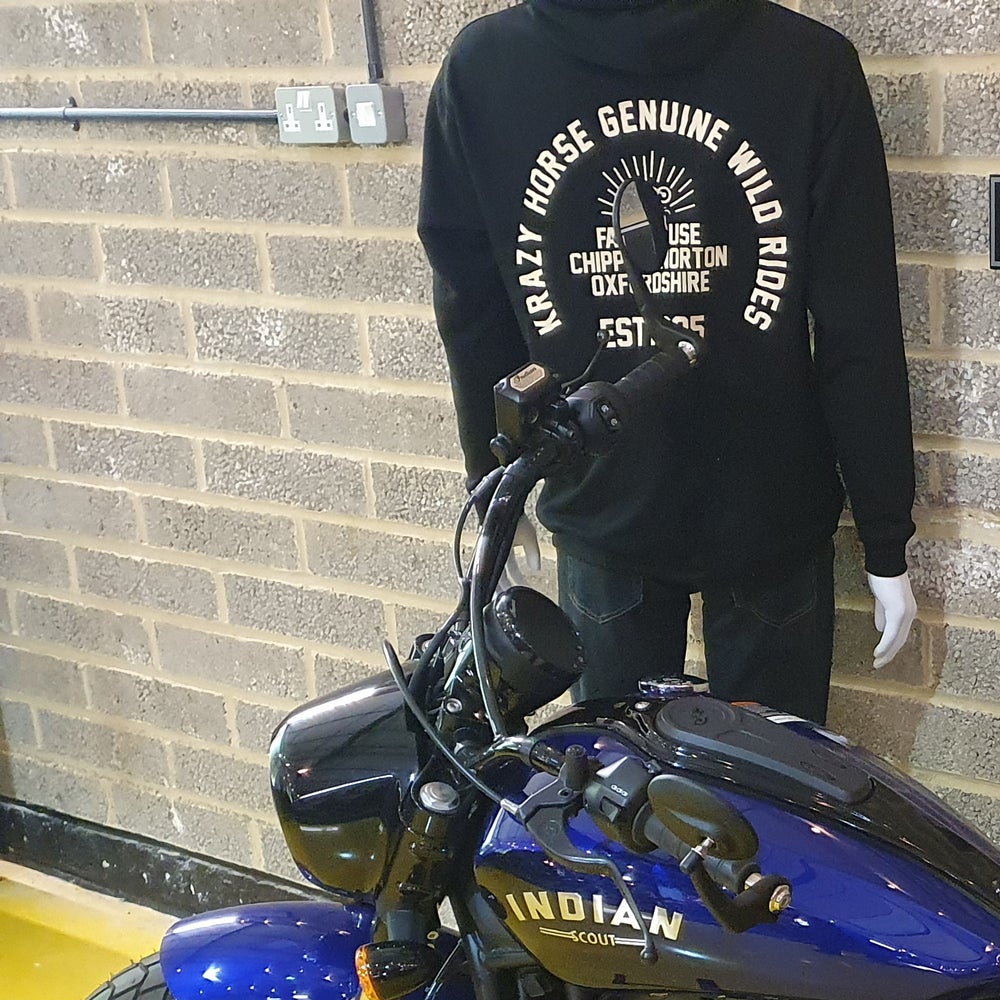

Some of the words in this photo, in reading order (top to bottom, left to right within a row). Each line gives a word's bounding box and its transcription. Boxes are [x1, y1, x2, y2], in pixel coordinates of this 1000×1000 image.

[598, 100, 730, 152] GENUINE
[523, 119, 595, 216] HORSE
[727, 140, 783, 224] WILD
[516, 223, 562, 336] KRAZY
[569, 250, 625, 275] CHIPP
[591, 270, 710, 297] OXFRDSHIRE
[744, 236, 787, 331] RIDES
[506, 891, 683, 941] INDIAN
[572, 930, 616, 947] SCOUT
